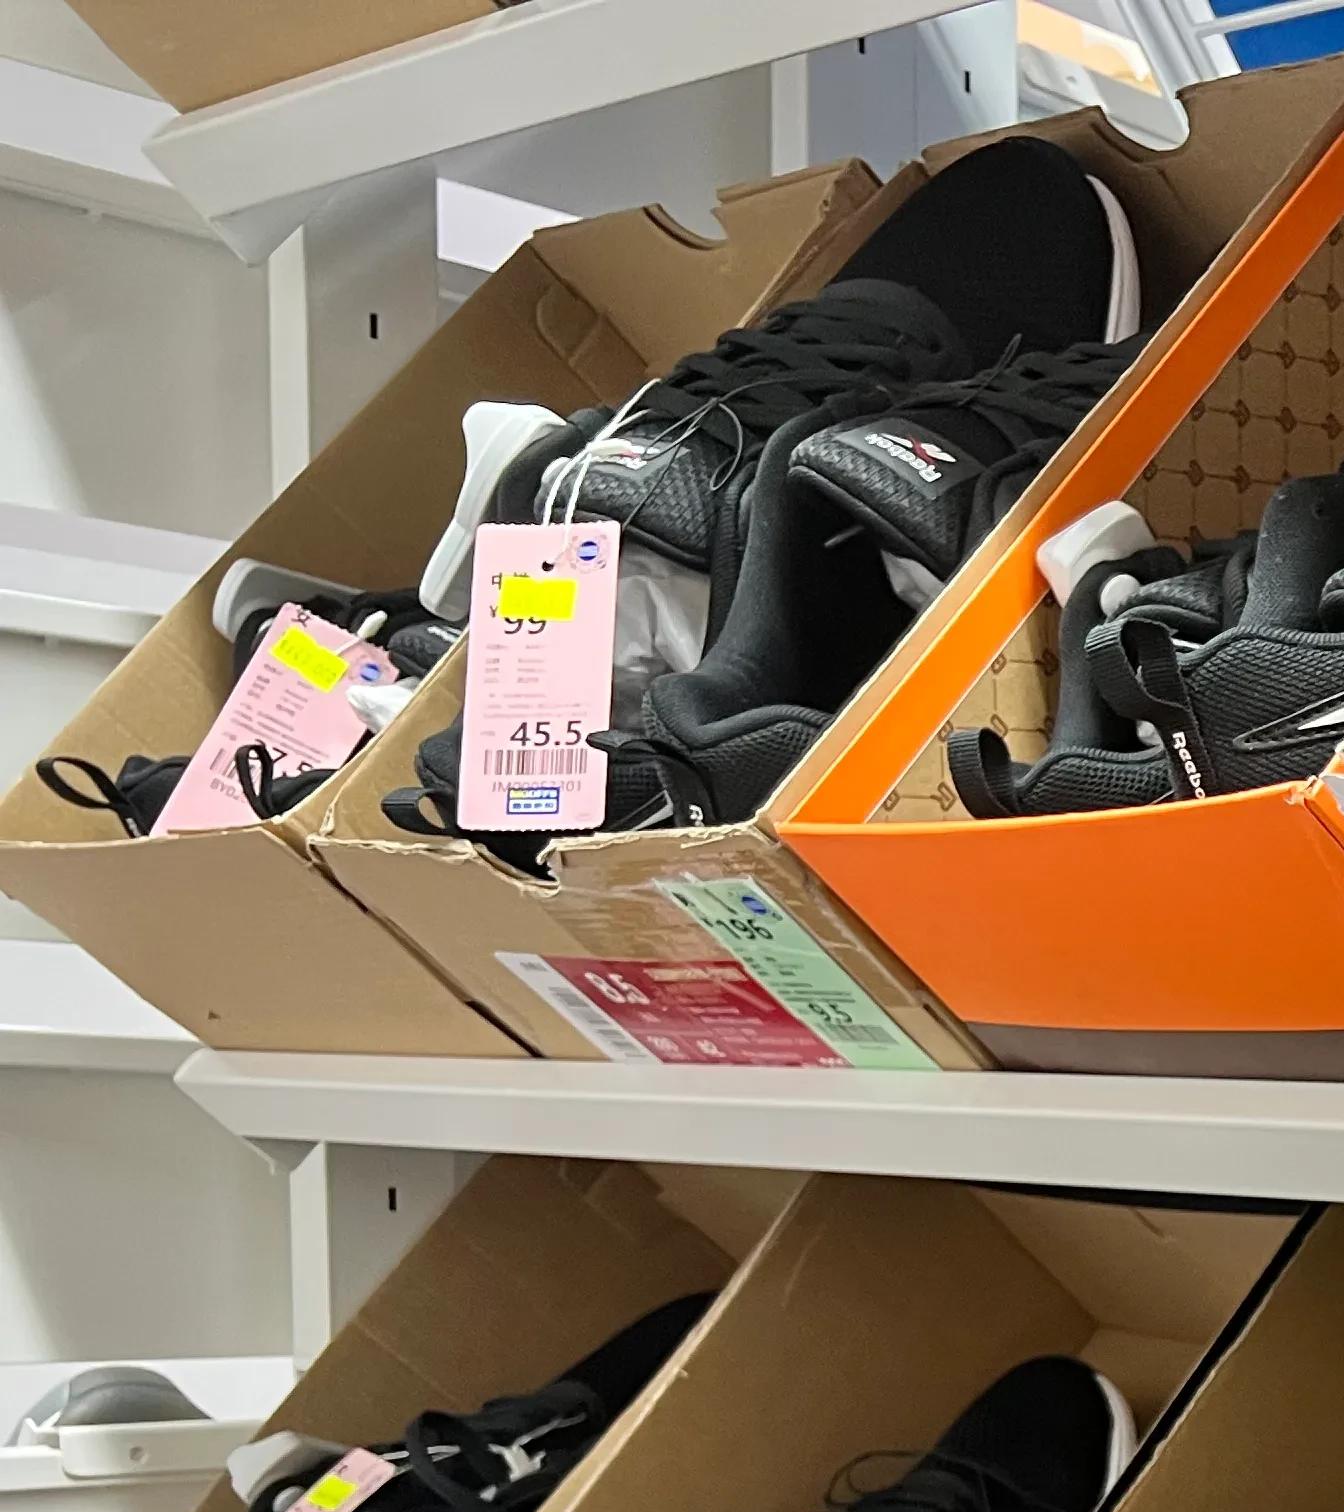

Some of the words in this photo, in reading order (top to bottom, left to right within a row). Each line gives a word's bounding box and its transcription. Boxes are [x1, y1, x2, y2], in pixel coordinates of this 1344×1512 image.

[864, 433, 942, 483] Reebok
[509, 720, 583, 747] 45.5
[1172, 731, 1206, 799] Reebo
